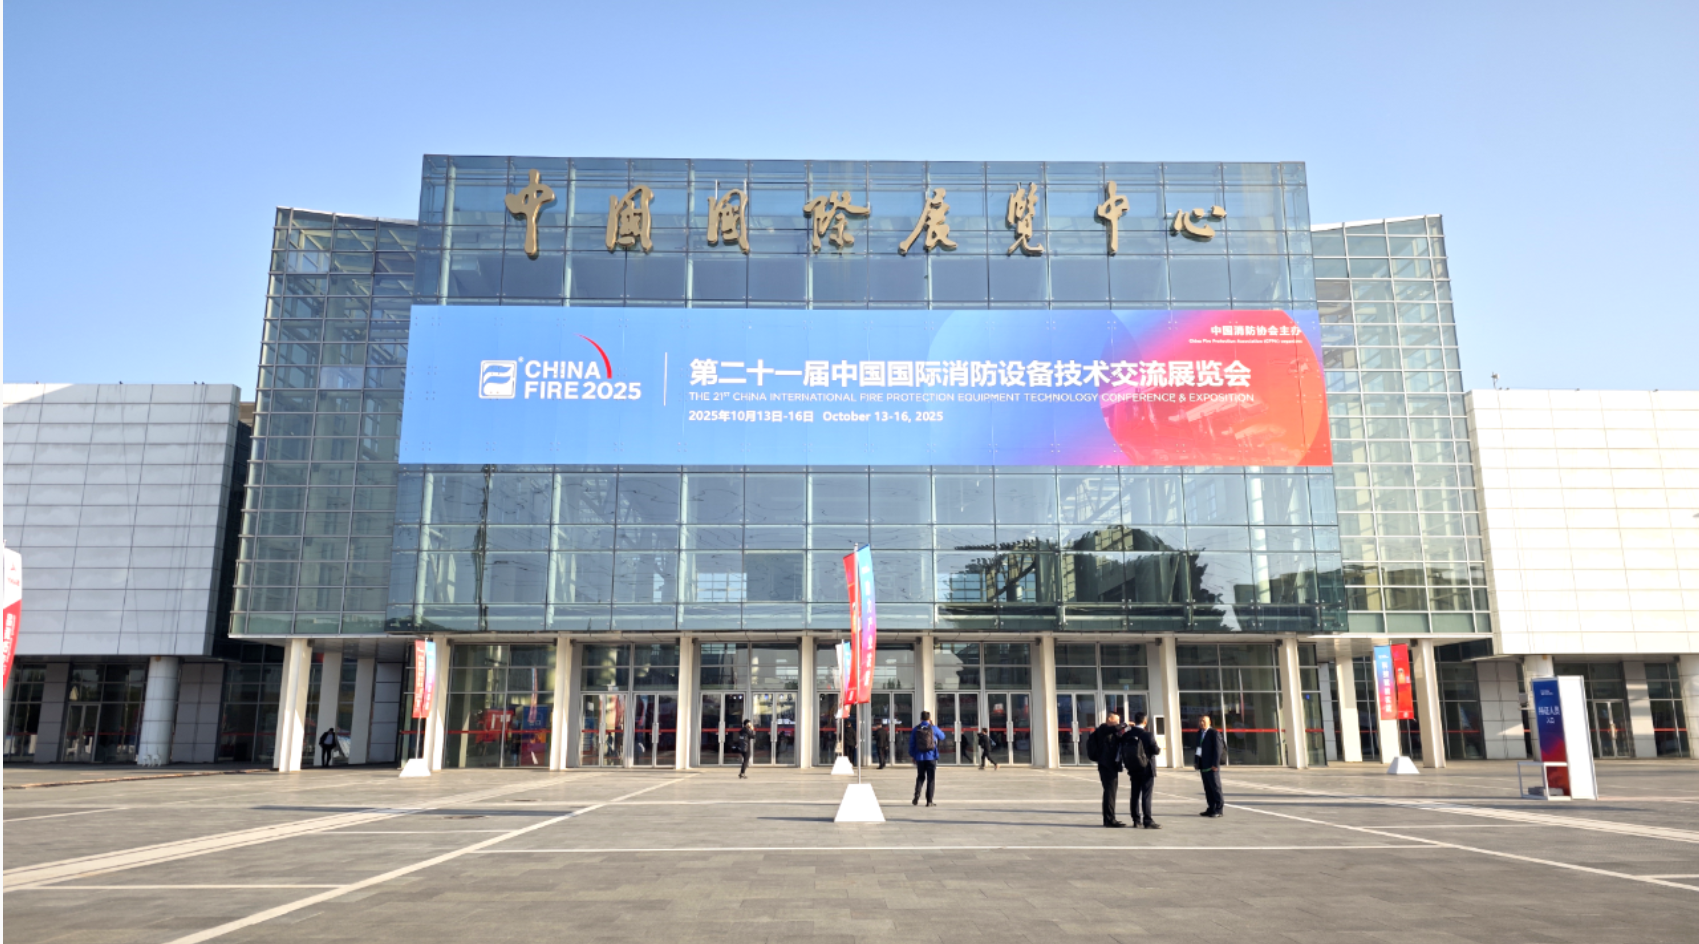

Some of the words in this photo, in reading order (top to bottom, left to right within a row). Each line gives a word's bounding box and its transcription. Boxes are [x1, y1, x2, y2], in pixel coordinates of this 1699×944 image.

[1211, 325, 1302, 336] 中国消防协会主办
[525, 360, 601, 379] CHINA
[689, 358, 1251, 388] 第二十一届中国国际消防设备技术交流展览会
[524, 381, 579, 399] FIRE
[581, 381, 642, 400] 2025
[689, 391, 710, 401] THE
[733, 392, 767, 401] CHINA
[770, 392, 857, 402] INTERNATIONAL
[860, 393, 883, 401] FIRE
[887, 393, 955, 402] PROTECTION
[958, 393, 1020, 402] EQUIPMENT
[1024, 393, 1098, 402] TECHNOLOGY
[1101, 393, 1176, 402] CONFERENCE
[1179, 393, 1186, 402] &
[1189, 393, 1254, 402] EXPOSITION
[688, 410, 814, 422] 2025年10月13日-16日
[822, 410, 871, 422] October
[874, 411, 911, 423] 13-16,
[915, 411, 944, 422] 2025
